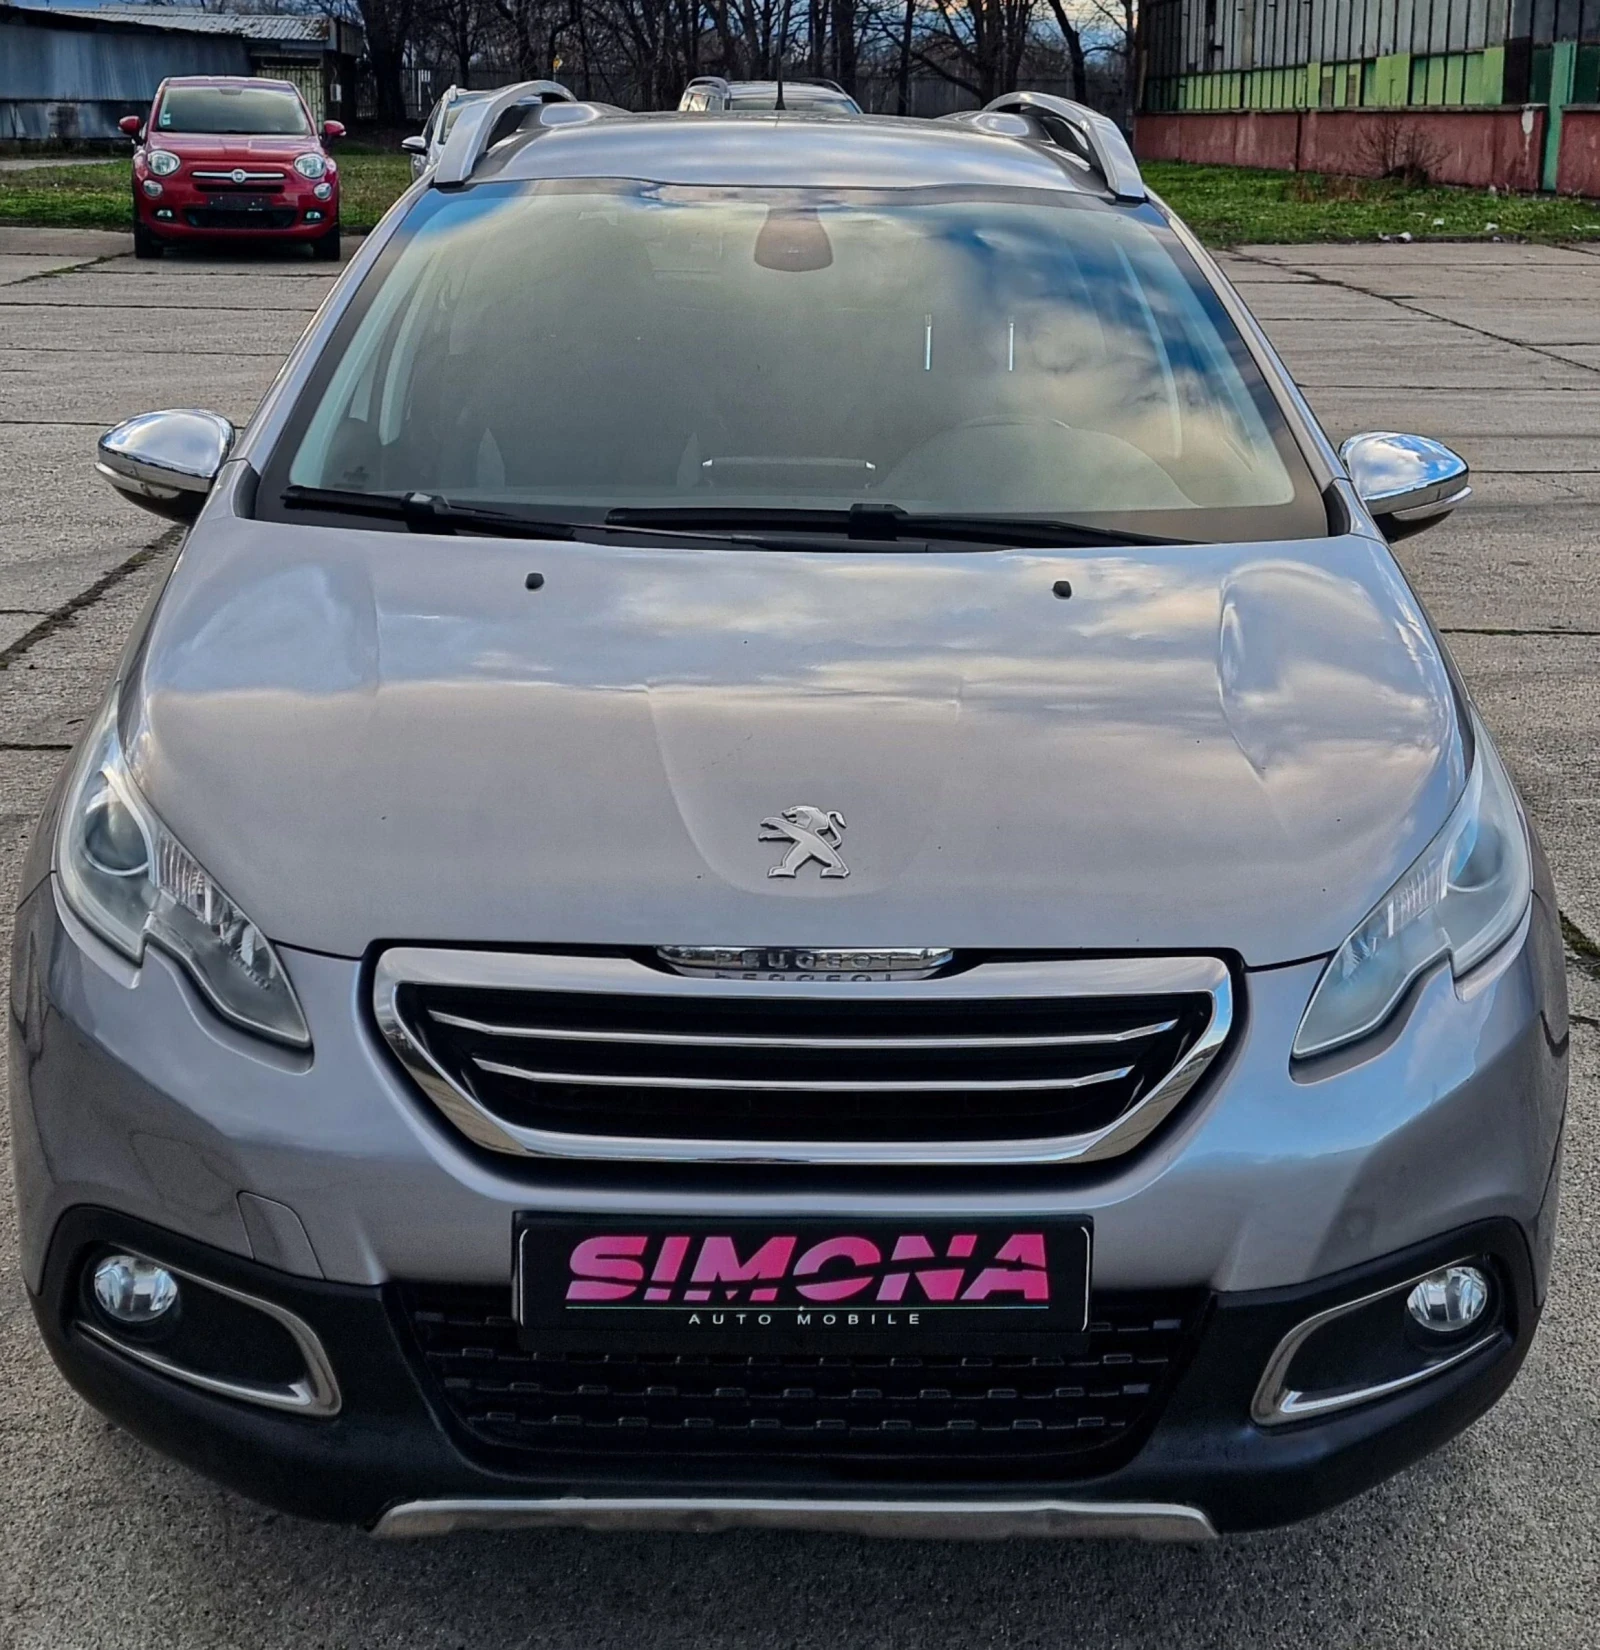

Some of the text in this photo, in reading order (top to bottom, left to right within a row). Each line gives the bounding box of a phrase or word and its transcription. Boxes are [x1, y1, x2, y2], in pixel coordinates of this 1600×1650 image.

[565, 1233, 1050, 1301] SIMONA
[688, 1313, 921, 1325] AUTO MOBILE
